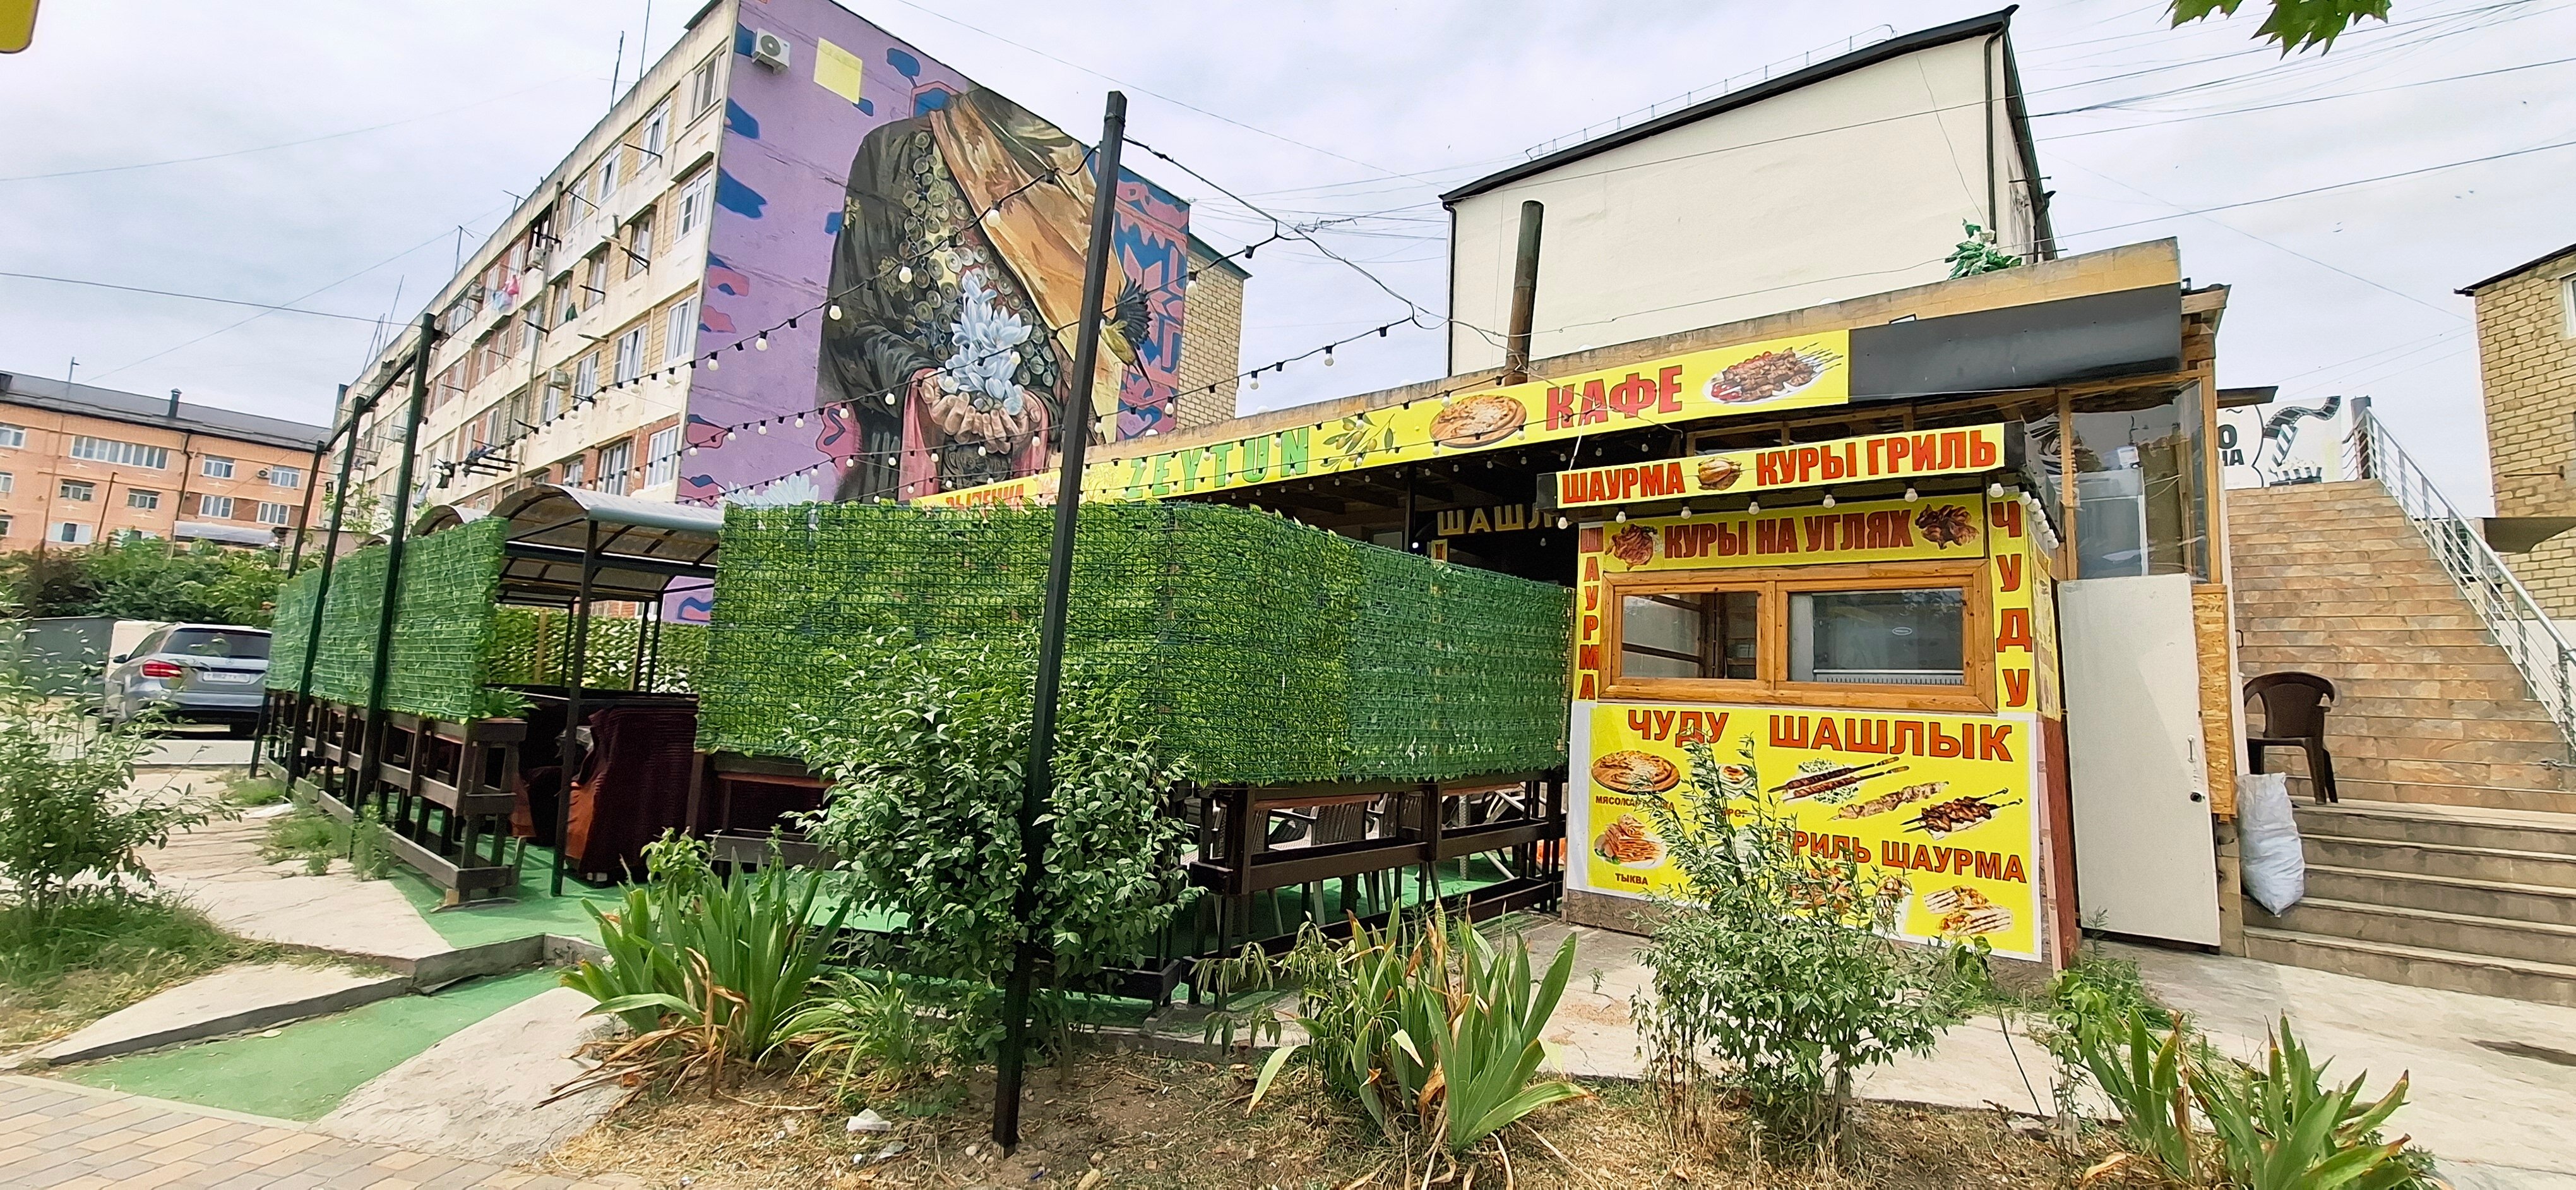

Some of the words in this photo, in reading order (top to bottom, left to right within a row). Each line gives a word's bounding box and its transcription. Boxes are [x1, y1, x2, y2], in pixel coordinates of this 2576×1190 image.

[1546, 364, 1683, 431] КАФЕ
[1125, 427, 1309, 500] ZEYTUN
[1561, 462, 1686, 504] ШАУРМА
[1755, 442, 1857, 486] КУРЫ
[1866, 430, 1997, 476] ГРИЛЬ
[1664, 520, 1749, 560] КУРЫ
[1755, 517, 1799, 555] НА
[1803, 508, 1914, 553] УГЛЯХ
[1578, 527, 1604, 700] ШАУРМА
[1989, 499, 2034, 707] ЧУДУ
[1628, 709, 1729, 748] ЧУДУ
[1769, 714, 2014, 762] ШАШЛЫК
[1614, 873, 1649, 886] ТЫКВА
[1881, 840, 2027, 884] ШАУРМА
